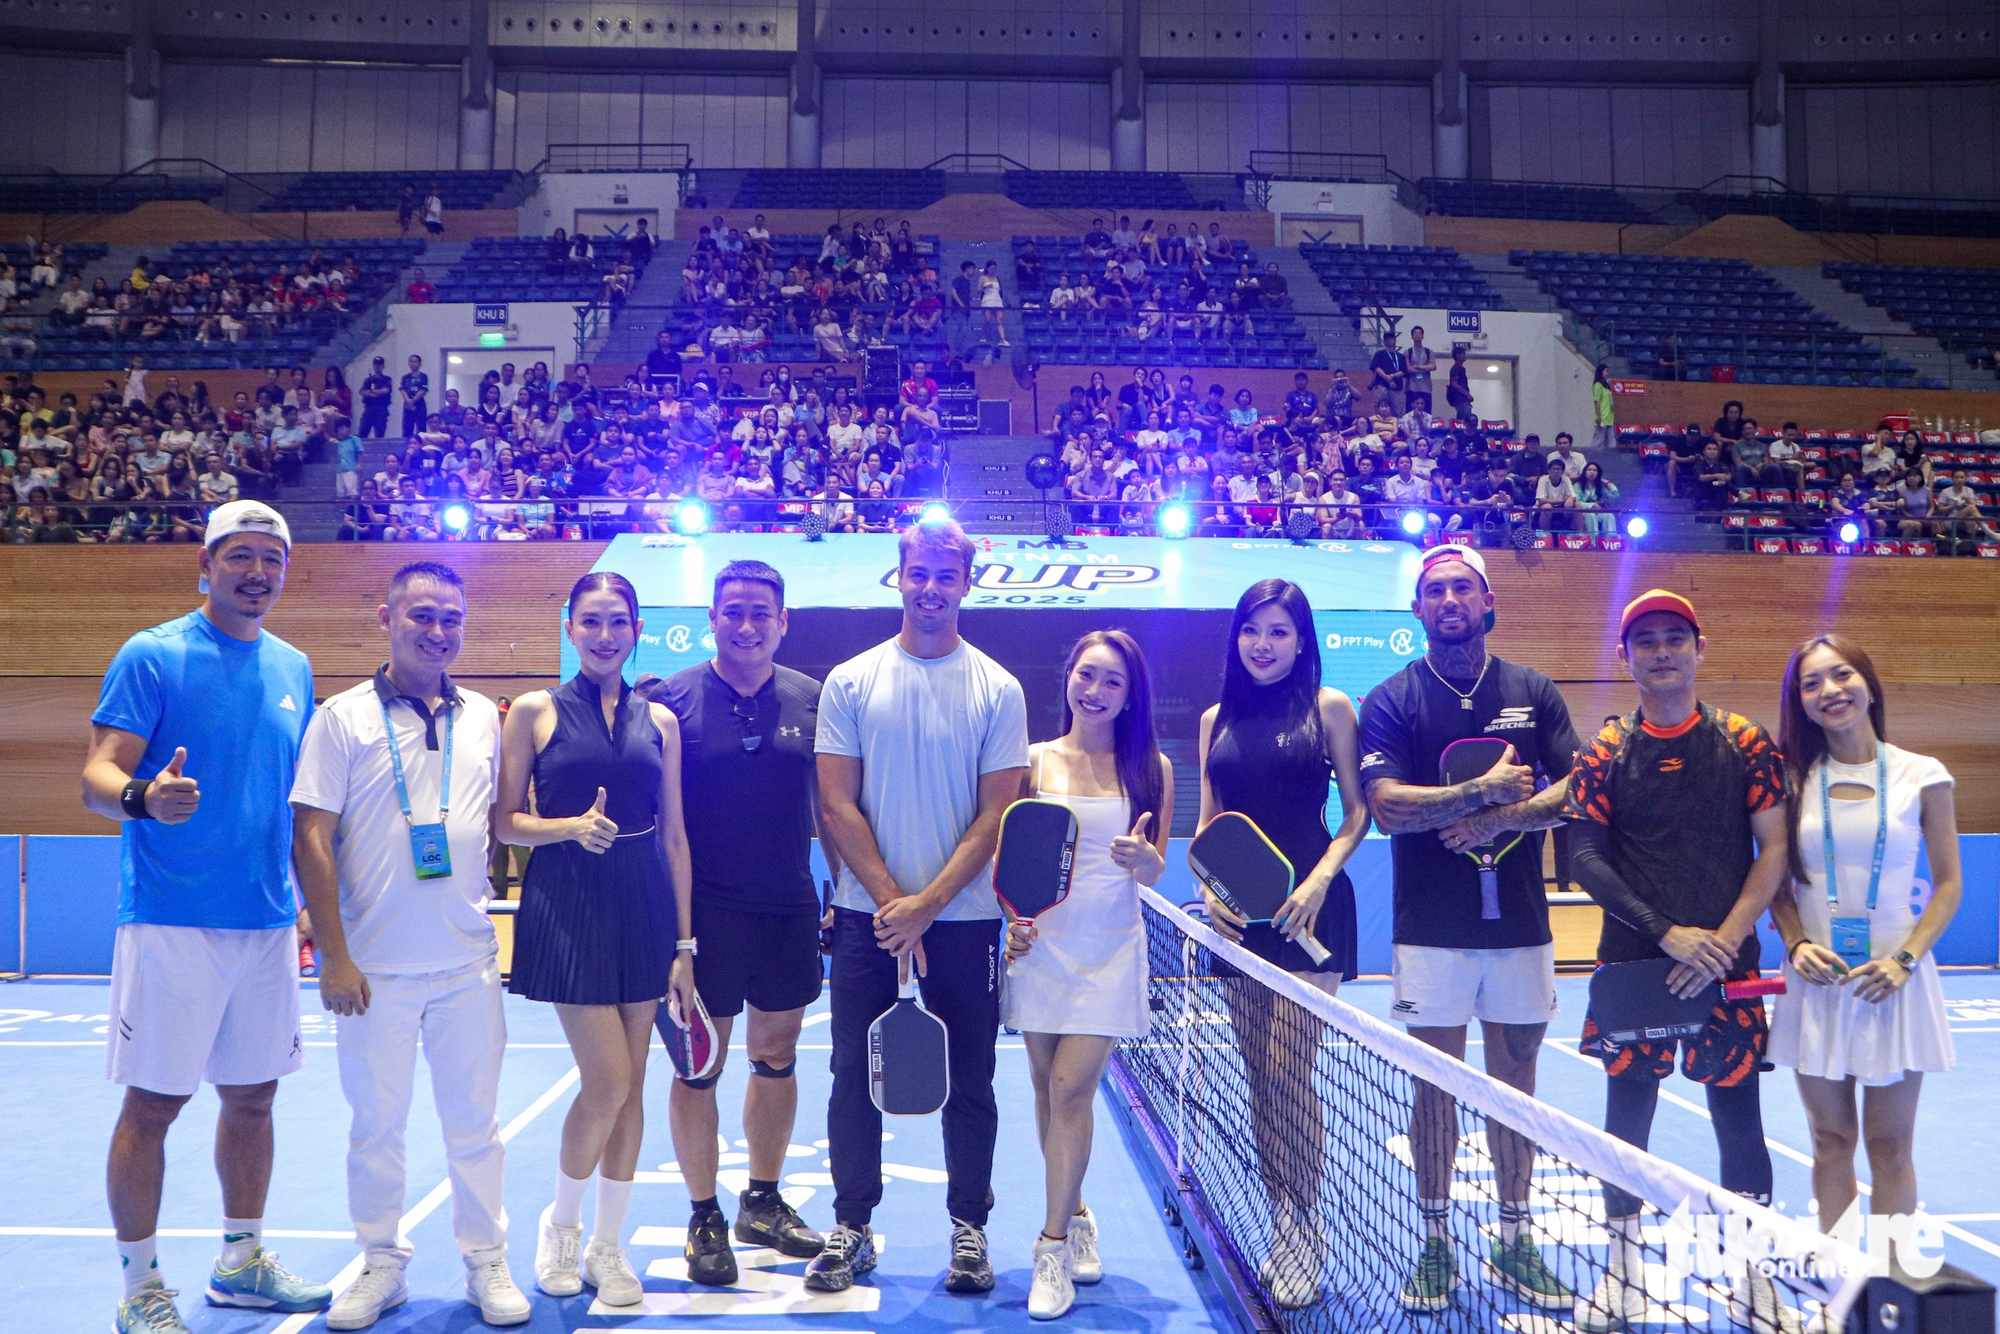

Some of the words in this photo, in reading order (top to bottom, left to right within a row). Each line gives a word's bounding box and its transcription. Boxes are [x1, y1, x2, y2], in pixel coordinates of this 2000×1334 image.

[477, 310, 497, 319] KHU
[499, 310, 505, 319] B
[1450, 316, 1469, 326] KHU
[1472, 317, 1478, 326] B
[1926, 435, 1941, 443] VIP
[1804, 451, 1820, 459] VIP
[1801, 495, 1818, 503] VIP
[785, 504, 804, 512] VIP
[1759, 518, 1777, 527] VIP
[1017, 540, 1088, 550] MB
[1448, 536, 1468, 545] VIP
[1565, 540, 1583, 549] VIP
[1603, 541, 1622, 550] VIP
[1760, 545, 1778, 553] VIP
[1799, 545, 1817, 553] VIP
[1874, 546, 1892, 554] VIP
[1908, 547, 1926, 555] VIP
[1979, 548, 1997, 557] VIP
[976, 552, 1120, 564] ETNAM
[974, 595, 1086, 604] 2025
[639, 634, 660, 645] Play
[1343, 637, 1361, 646] FPT
[1364, 637, 1384, 648] Play
[422, 854, 441, 862] LOC
[1063, 853, 1071, 868] JOOLA
[1647, 1029, 1665, 1037] JOOLA
